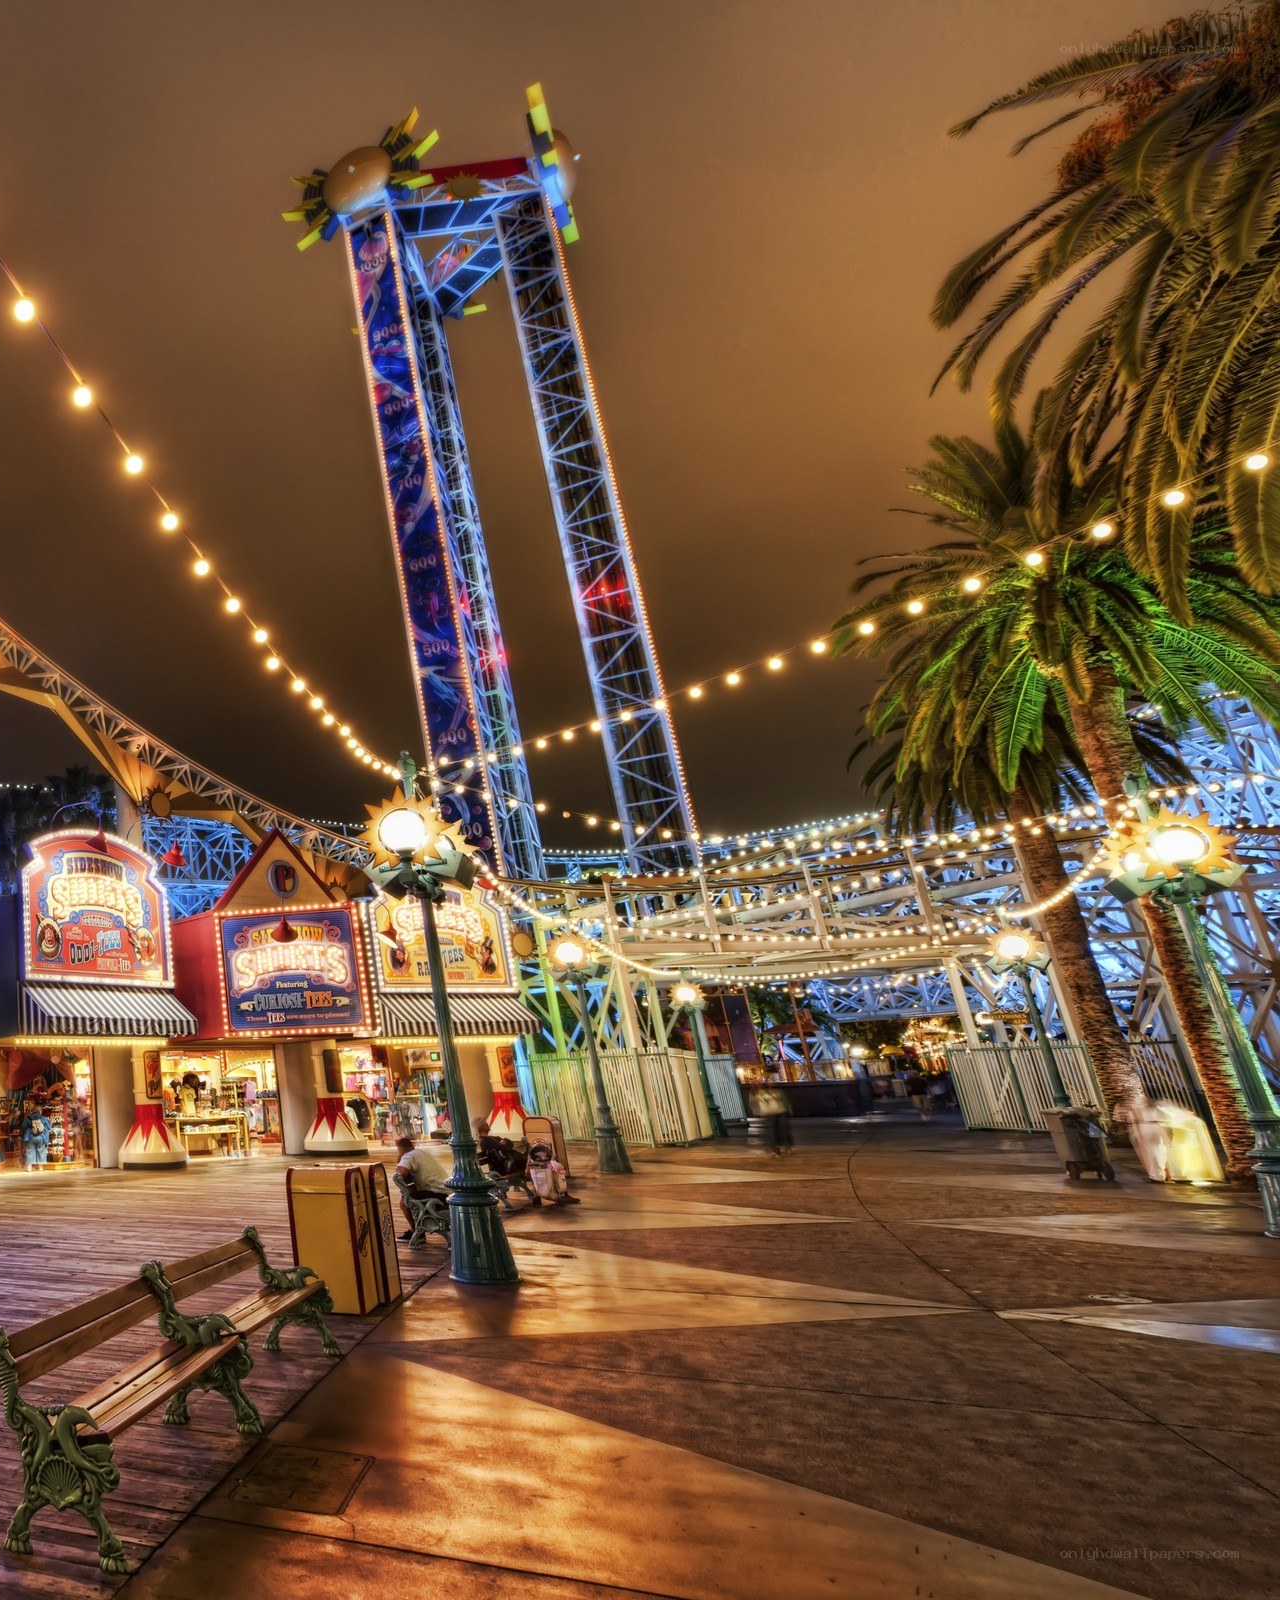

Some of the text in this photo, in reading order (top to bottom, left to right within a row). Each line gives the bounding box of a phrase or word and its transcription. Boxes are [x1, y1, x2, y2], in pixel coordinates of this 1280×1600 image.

[360, 253, 388, 273] 1000
[372, 323, 399, 342] 900
[384, 397, 409, 415] 800
[397, 474, 422, 491] 700
[410, 553, 437, 571] 600
[422, 639, 450, 657] 500
[438, 727, 467, 744] 400
[460, 822, 483, 839] 00
[65, 856, 124, 881] SIDESHOW
[274, 865, 296, 893] P
[51, 877, 142, 928] SHIRTS
[396, 905, 482, 944] SHRTS
[251, 925, 324, 947] SIDHOW
[235, 944, 348, 989] SHIRTS
[275, 981, 308, 989] Featuring
[253, 991, 333, 1010] CURIOSI-TEES
[267, 1012, 286, 1023] TEES
